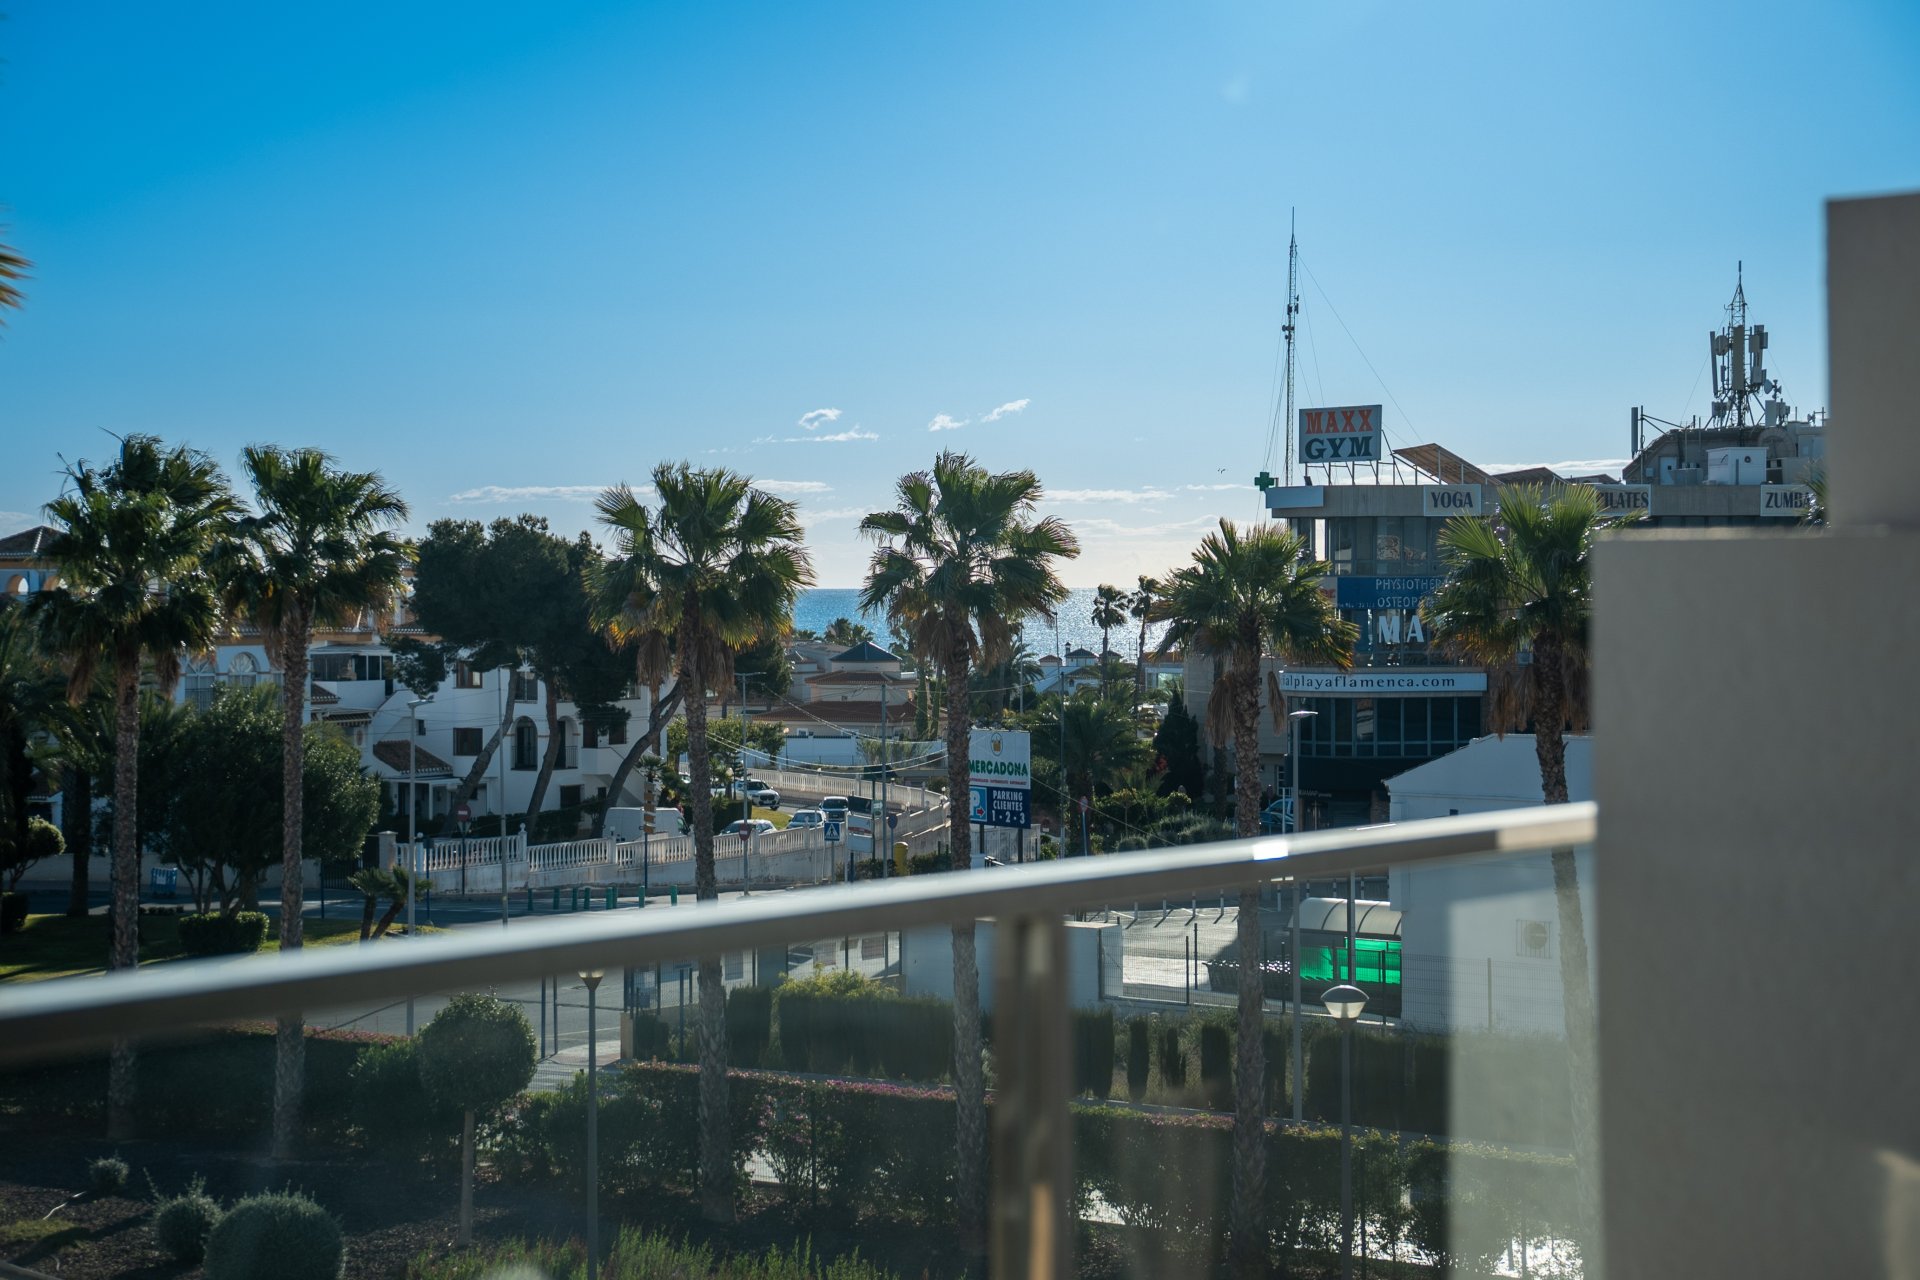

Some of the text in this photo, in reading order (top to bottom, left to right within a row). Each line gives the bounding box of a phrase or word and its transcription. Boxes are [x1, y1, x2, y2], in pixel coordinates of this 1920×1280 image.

[1305, 409, 1373, 435] MAXX
[1305, 436, 1373, 459] GYM
[1431, 491, 1473, 508] YOGA
[1599, 491, 1649, 508] ILATES
[1375, 578, 1446, 590] PHYSIOTHER
[1377, 596, 1420, 608] OSTEOP
[1281, 675, 1455, 690] ialplayaflamenca.com
[968, 760, 1029, 776] MERCADONA
[992, 790, 1023, 801] PARKING
[992, 801, 1023, 811] CLIENTES
